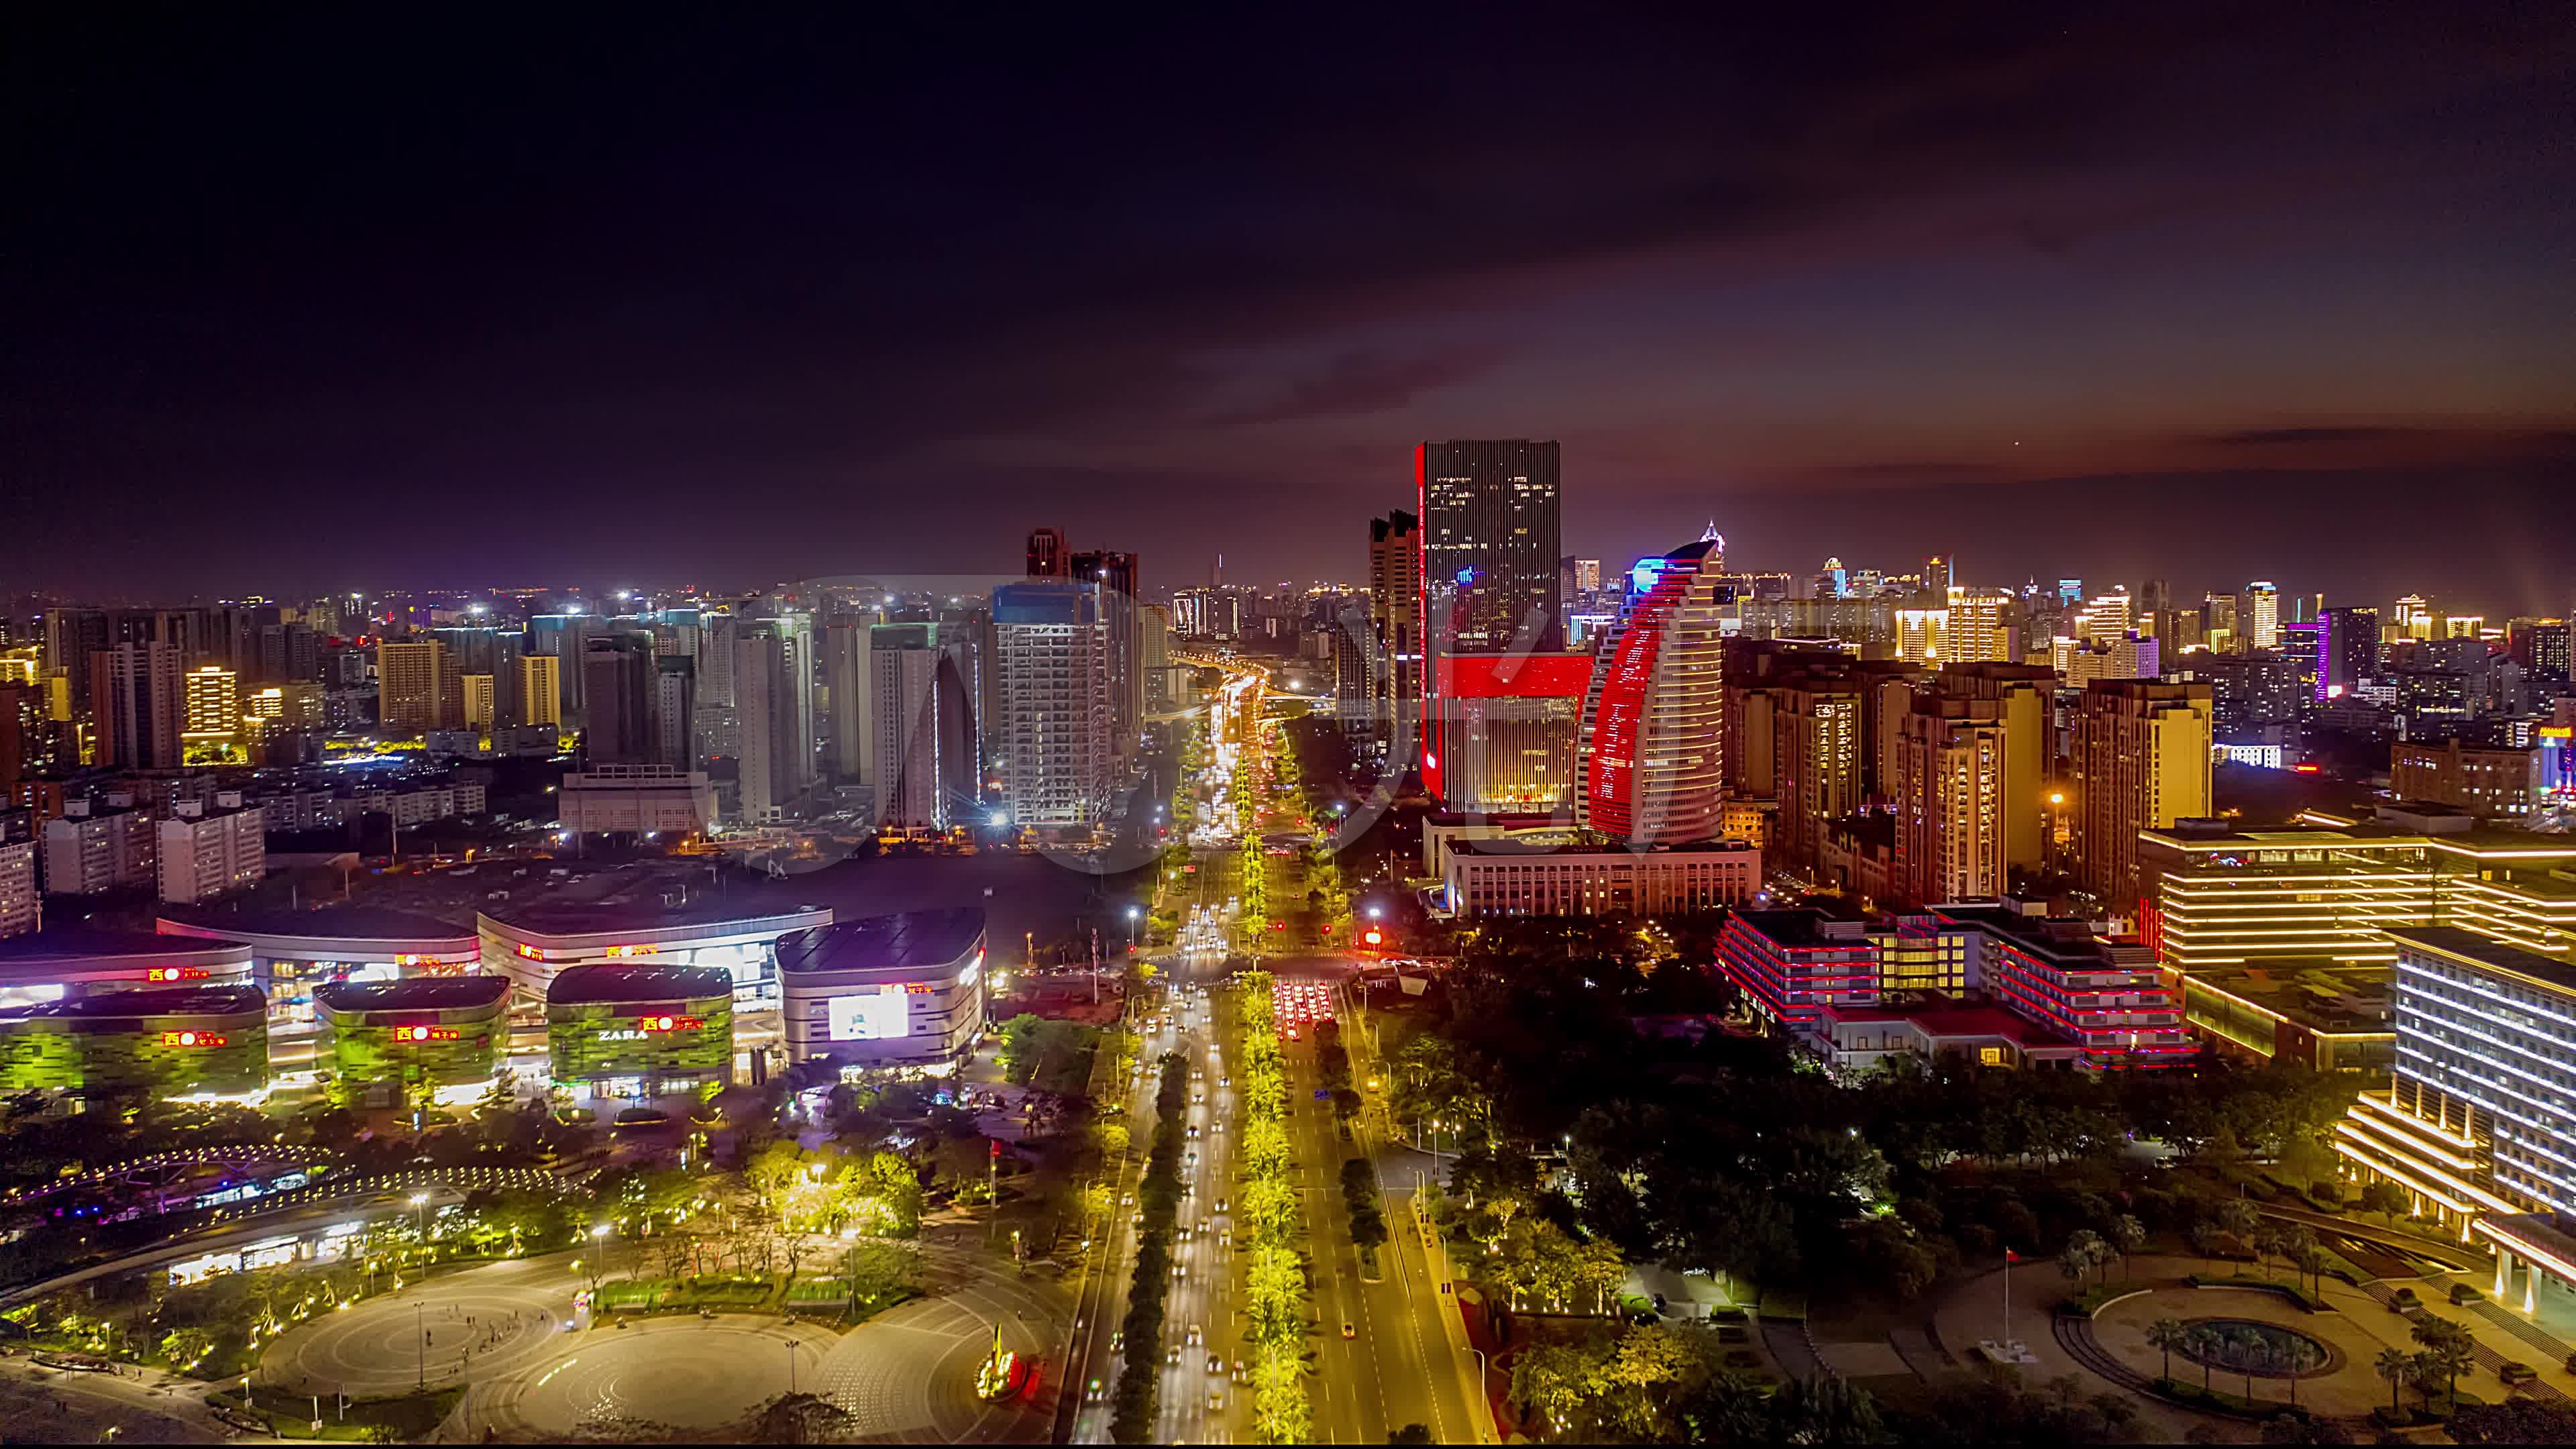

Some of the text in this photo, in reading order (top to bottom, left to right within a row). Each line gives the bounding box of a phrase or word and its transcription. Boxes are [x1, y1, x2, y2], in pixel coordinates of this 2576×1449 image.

[148, 969, 163, 981] 西
[643, 1017, 658, 1030] 西
[164, 1032, 180, 1046] 西
[397, 1027, 412, 1040] 西
[598, 1030, 649, 1041] ZARA
